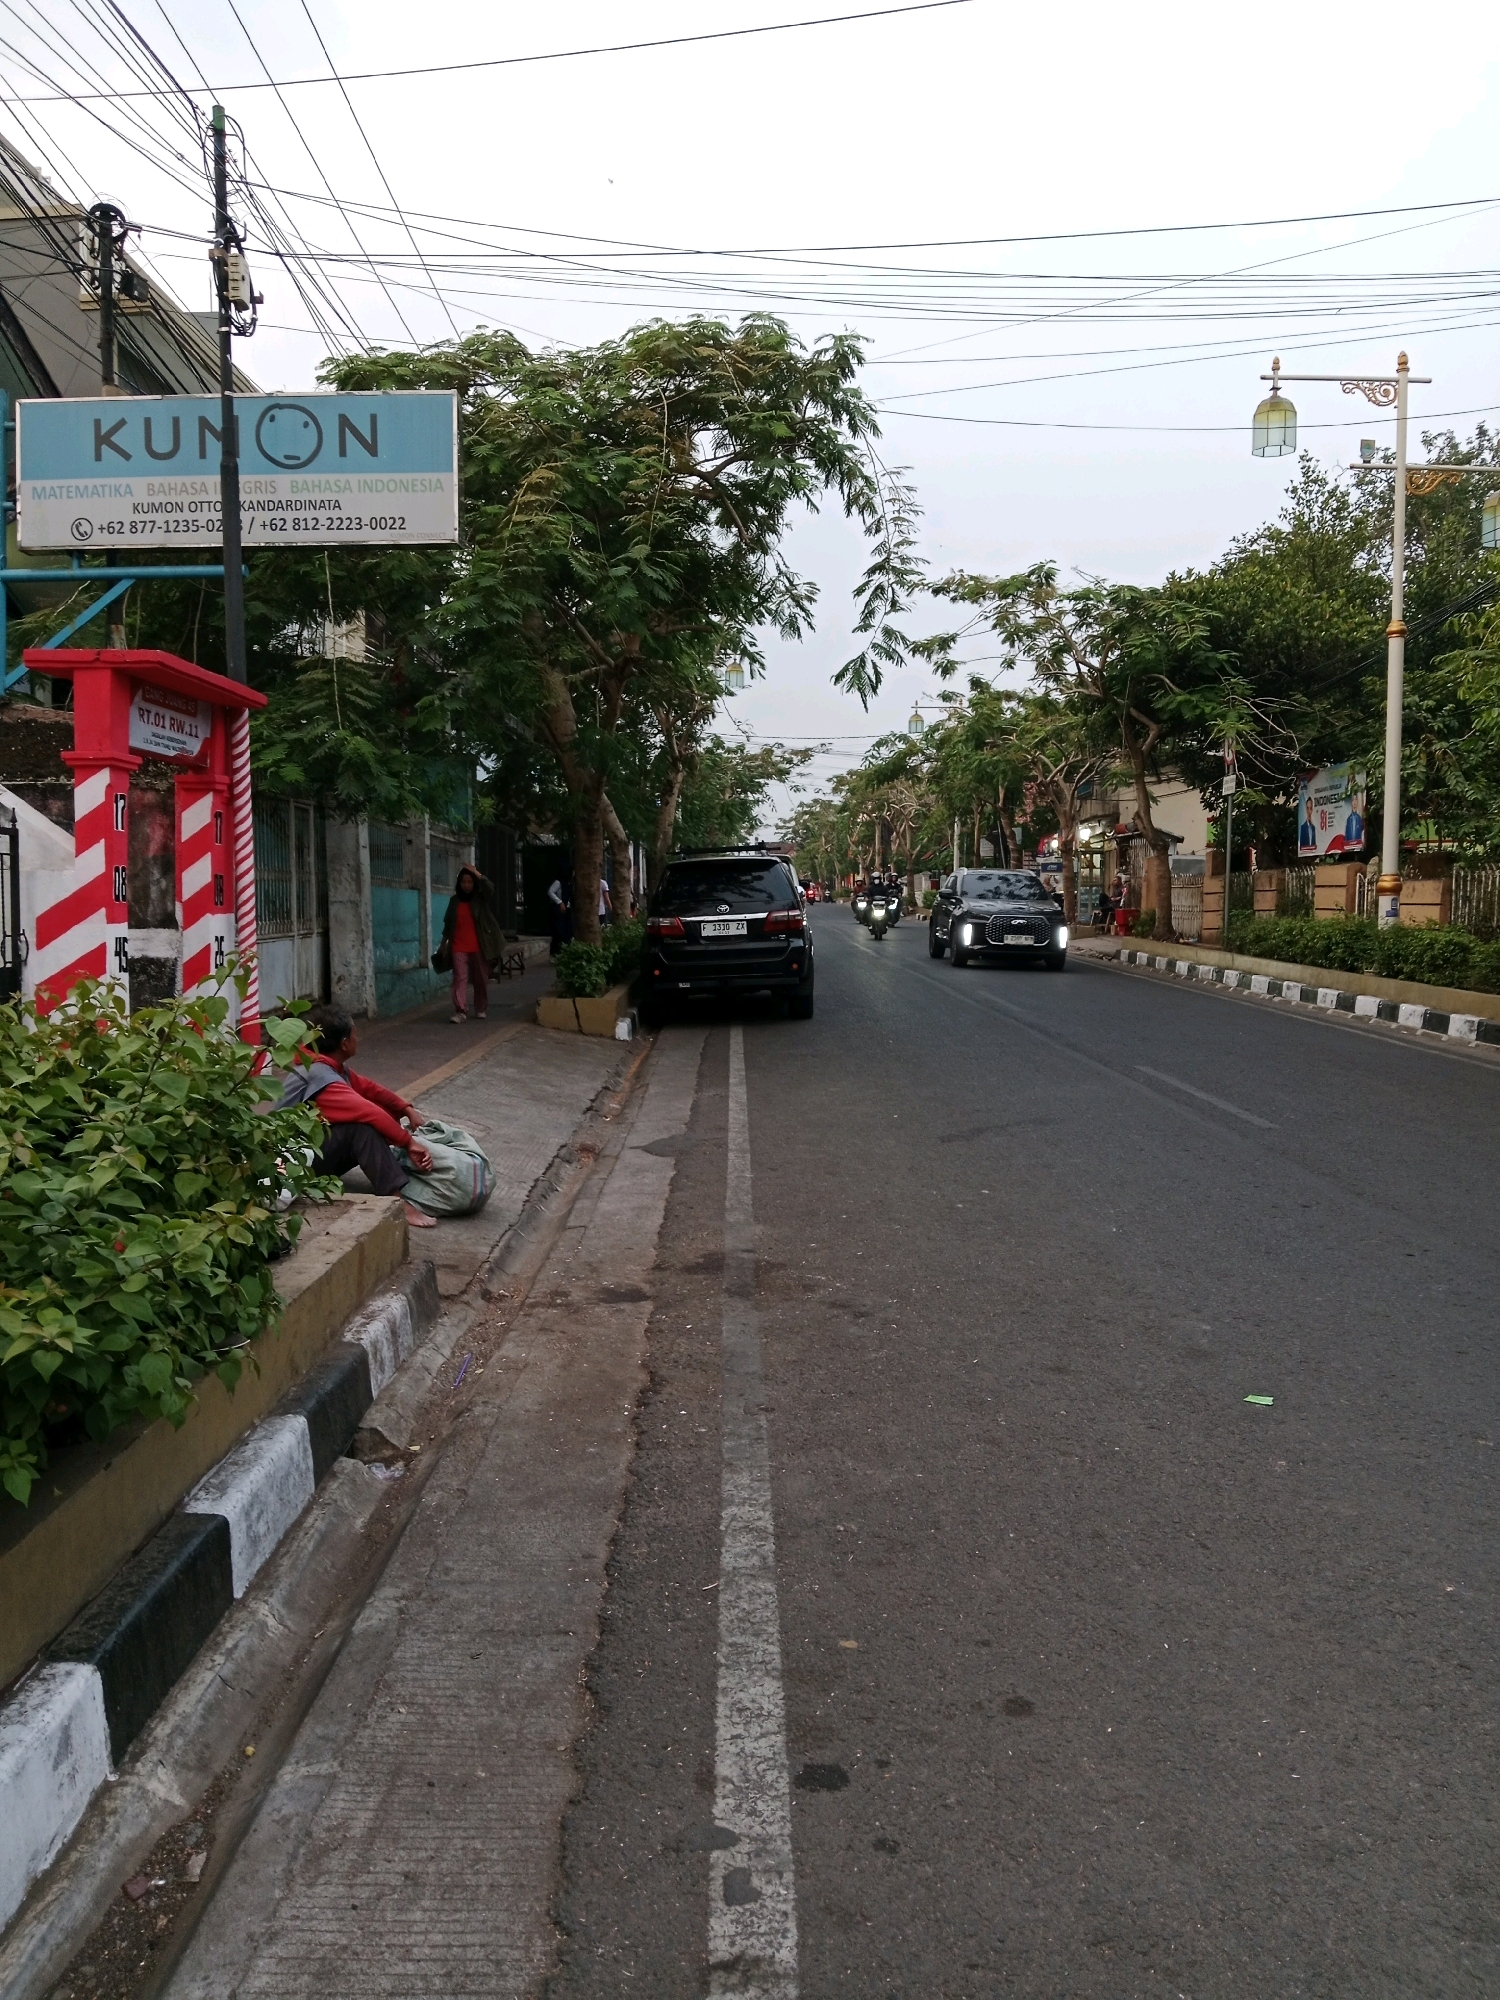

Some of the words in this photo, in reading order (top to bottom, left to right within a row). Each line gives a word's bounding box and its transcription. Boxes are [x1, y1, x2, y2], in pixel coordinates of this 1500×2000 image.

[93, 403, 379, 469] KUMON
[32, 483, 134, 500] MATEMATIKA
[147, 481, 209, 497] BAHASA
[213, 480, 277, 496] IGRIS
[290, 478, 353, 494] BAHASA
[357, 478, 445, 494] INDONESIA
[132, 501, 184, 514] KUMON
[188, 501, 223, 513] OTTO
[240, 499, 342, 512] KANDARDINATA
[98, 520, 125, 535] +62
[247, 516, 255, 534] /
[259, 517, 288, 532] +62
[292, 515, 407, 532] 812-2223-0022
[138, 706, 166, 730] RT.01
[169, 716, 199, 739] RW.11
[114, 793, 127, 831] 17
[113, 865, 127, 903] 08
[702, 924, 708, 932] F
[736, 922, 746, 931] ZX
[114, 936, 128, 973] 45
